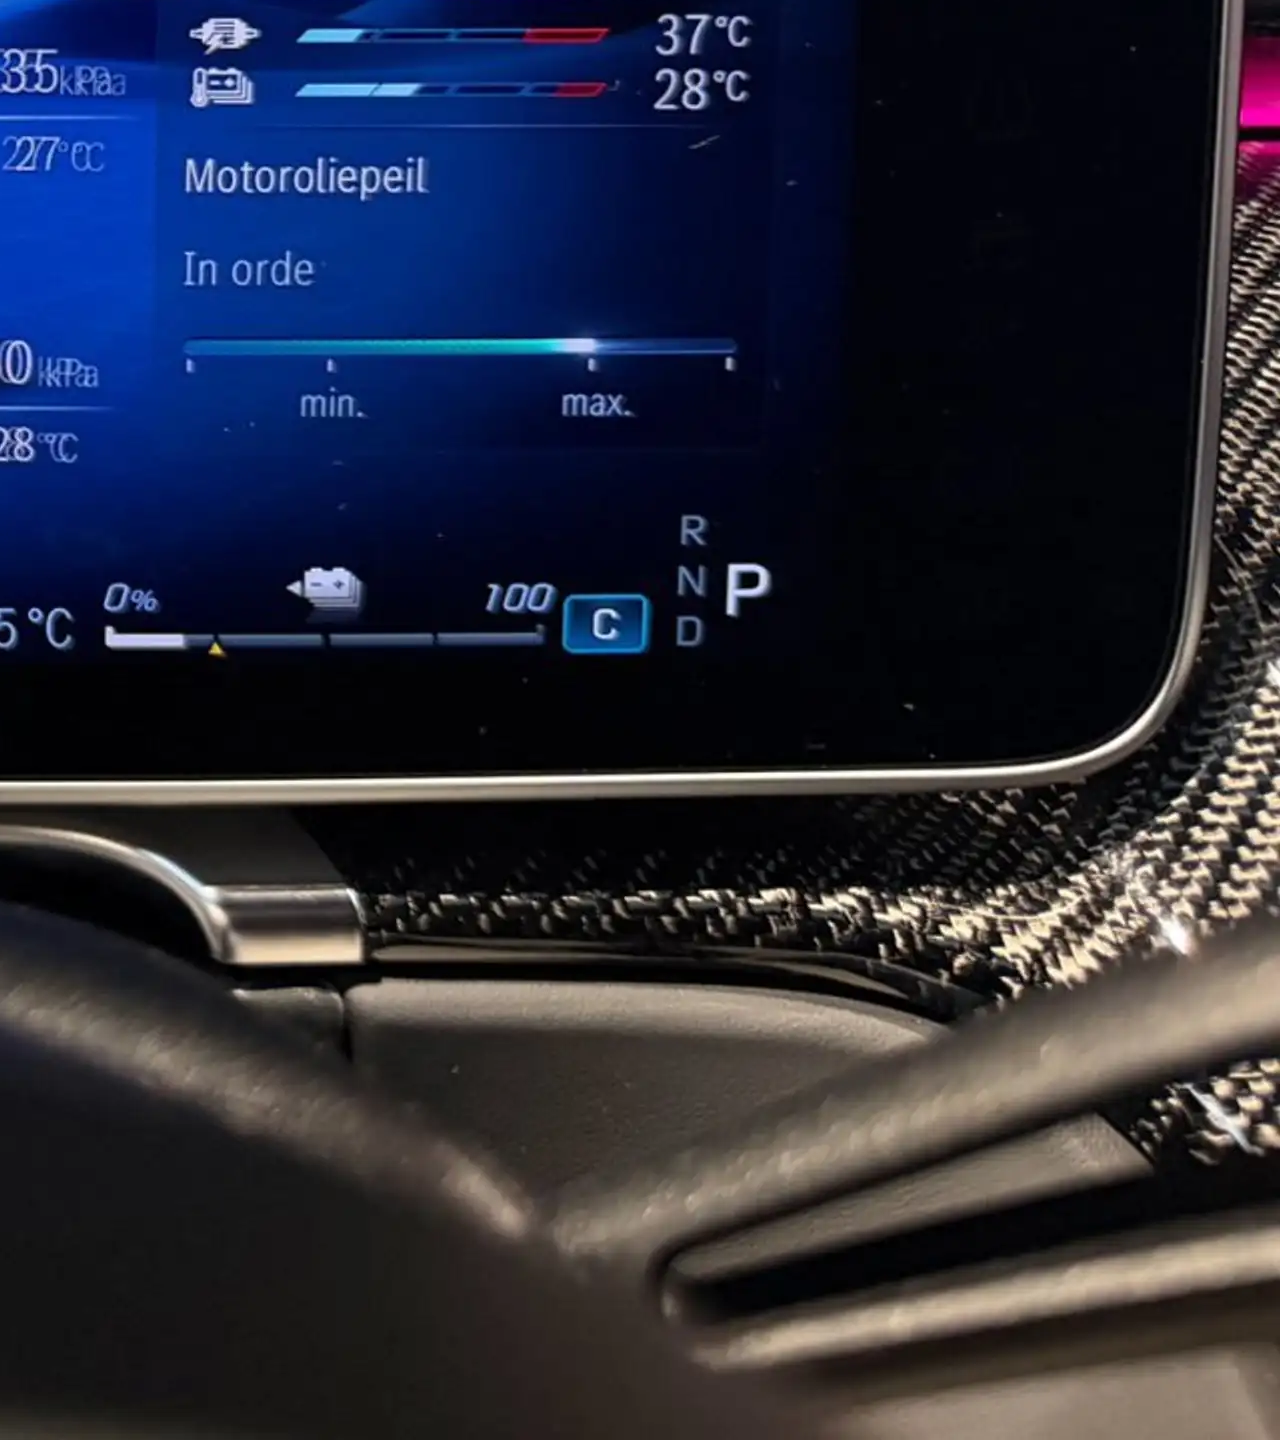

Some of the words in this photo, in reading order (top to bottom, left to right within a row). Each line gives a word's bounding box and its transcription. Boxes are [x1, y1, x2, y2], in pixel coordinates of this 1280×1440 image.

[655, 14, 752, 56] 37°C
[653, 69, 750, 111] 28°C
[183, 157, 430, 201] Motoroliepeil
[183, 251, 217, 286] In
[231, 251, 314, 287] orde
[300, 390, 365, 418] min.
[561, 391, 633, 418] max.
[680, 514, 708, 546] R
[677, 565, 706, 597] N
[725, 563, 772, 617] P
[485, 583, 557, 614] 100
[593, 608, 621, 640] C
[676, 616, 704, 647] D
